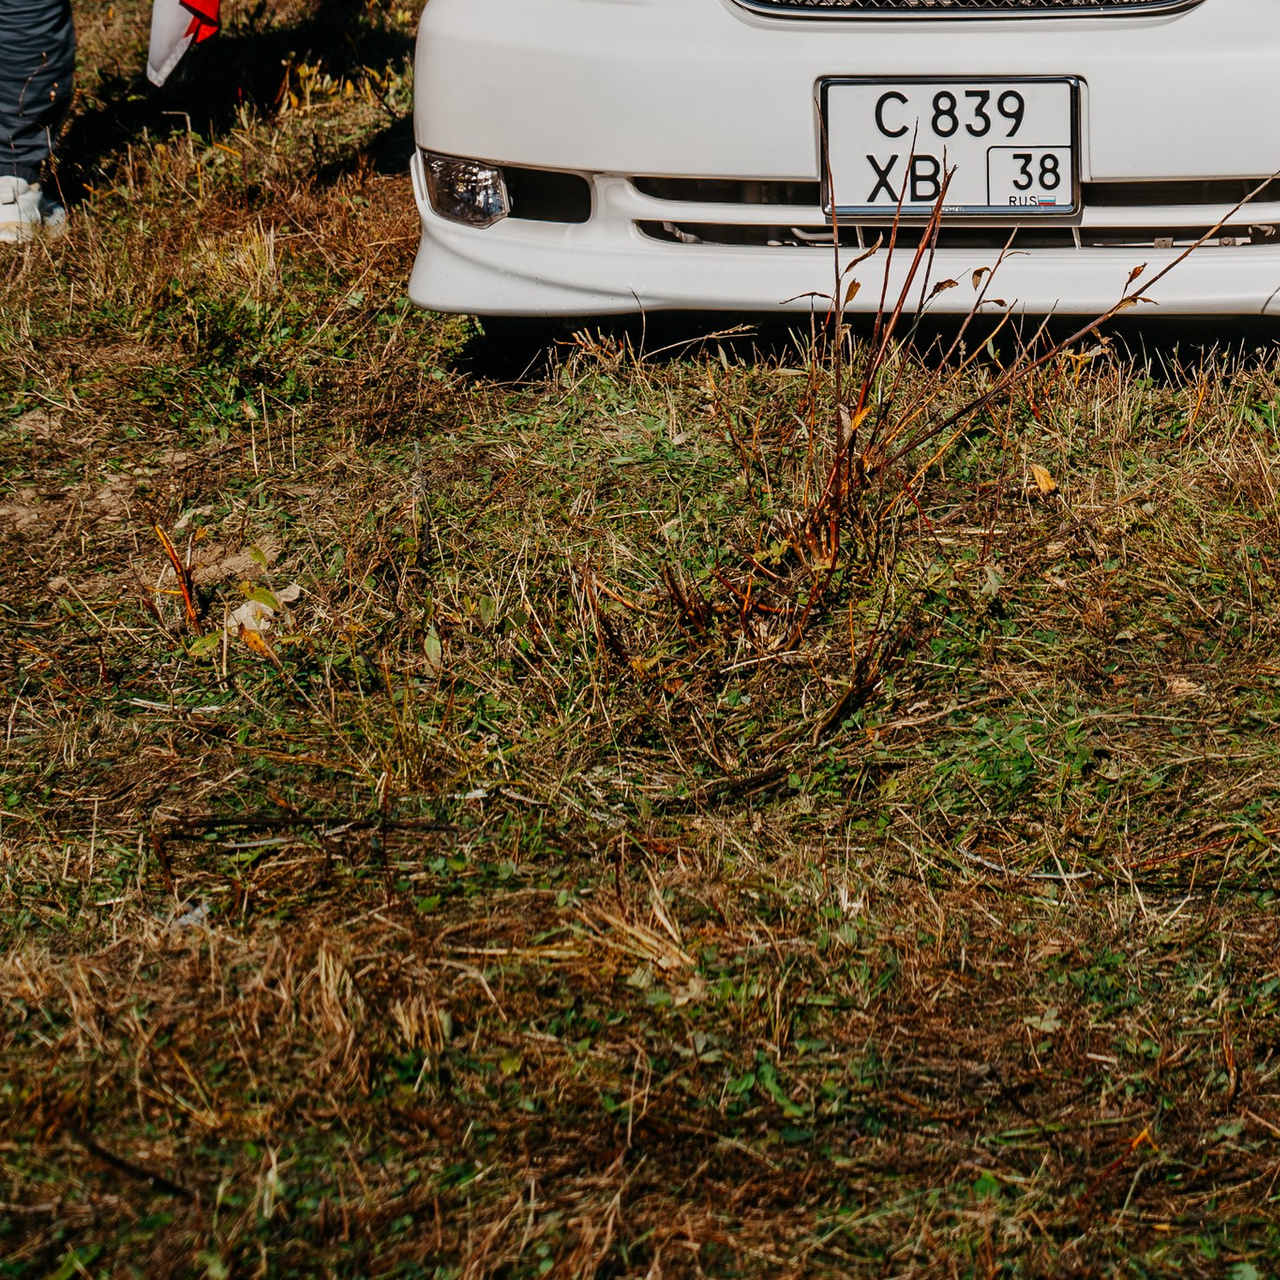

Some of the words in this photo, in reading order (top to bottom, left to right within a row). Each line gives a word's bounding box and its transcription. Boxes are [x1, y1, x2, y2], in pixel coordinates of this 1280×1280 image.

[875, 91, 909, 138] С
[931, 90, 1025, 138] 839
[866, 154, 941, 203] ХВ
[1012, 153, 1060, 190] 38
[1009, 195, 1037, 206] RUS
